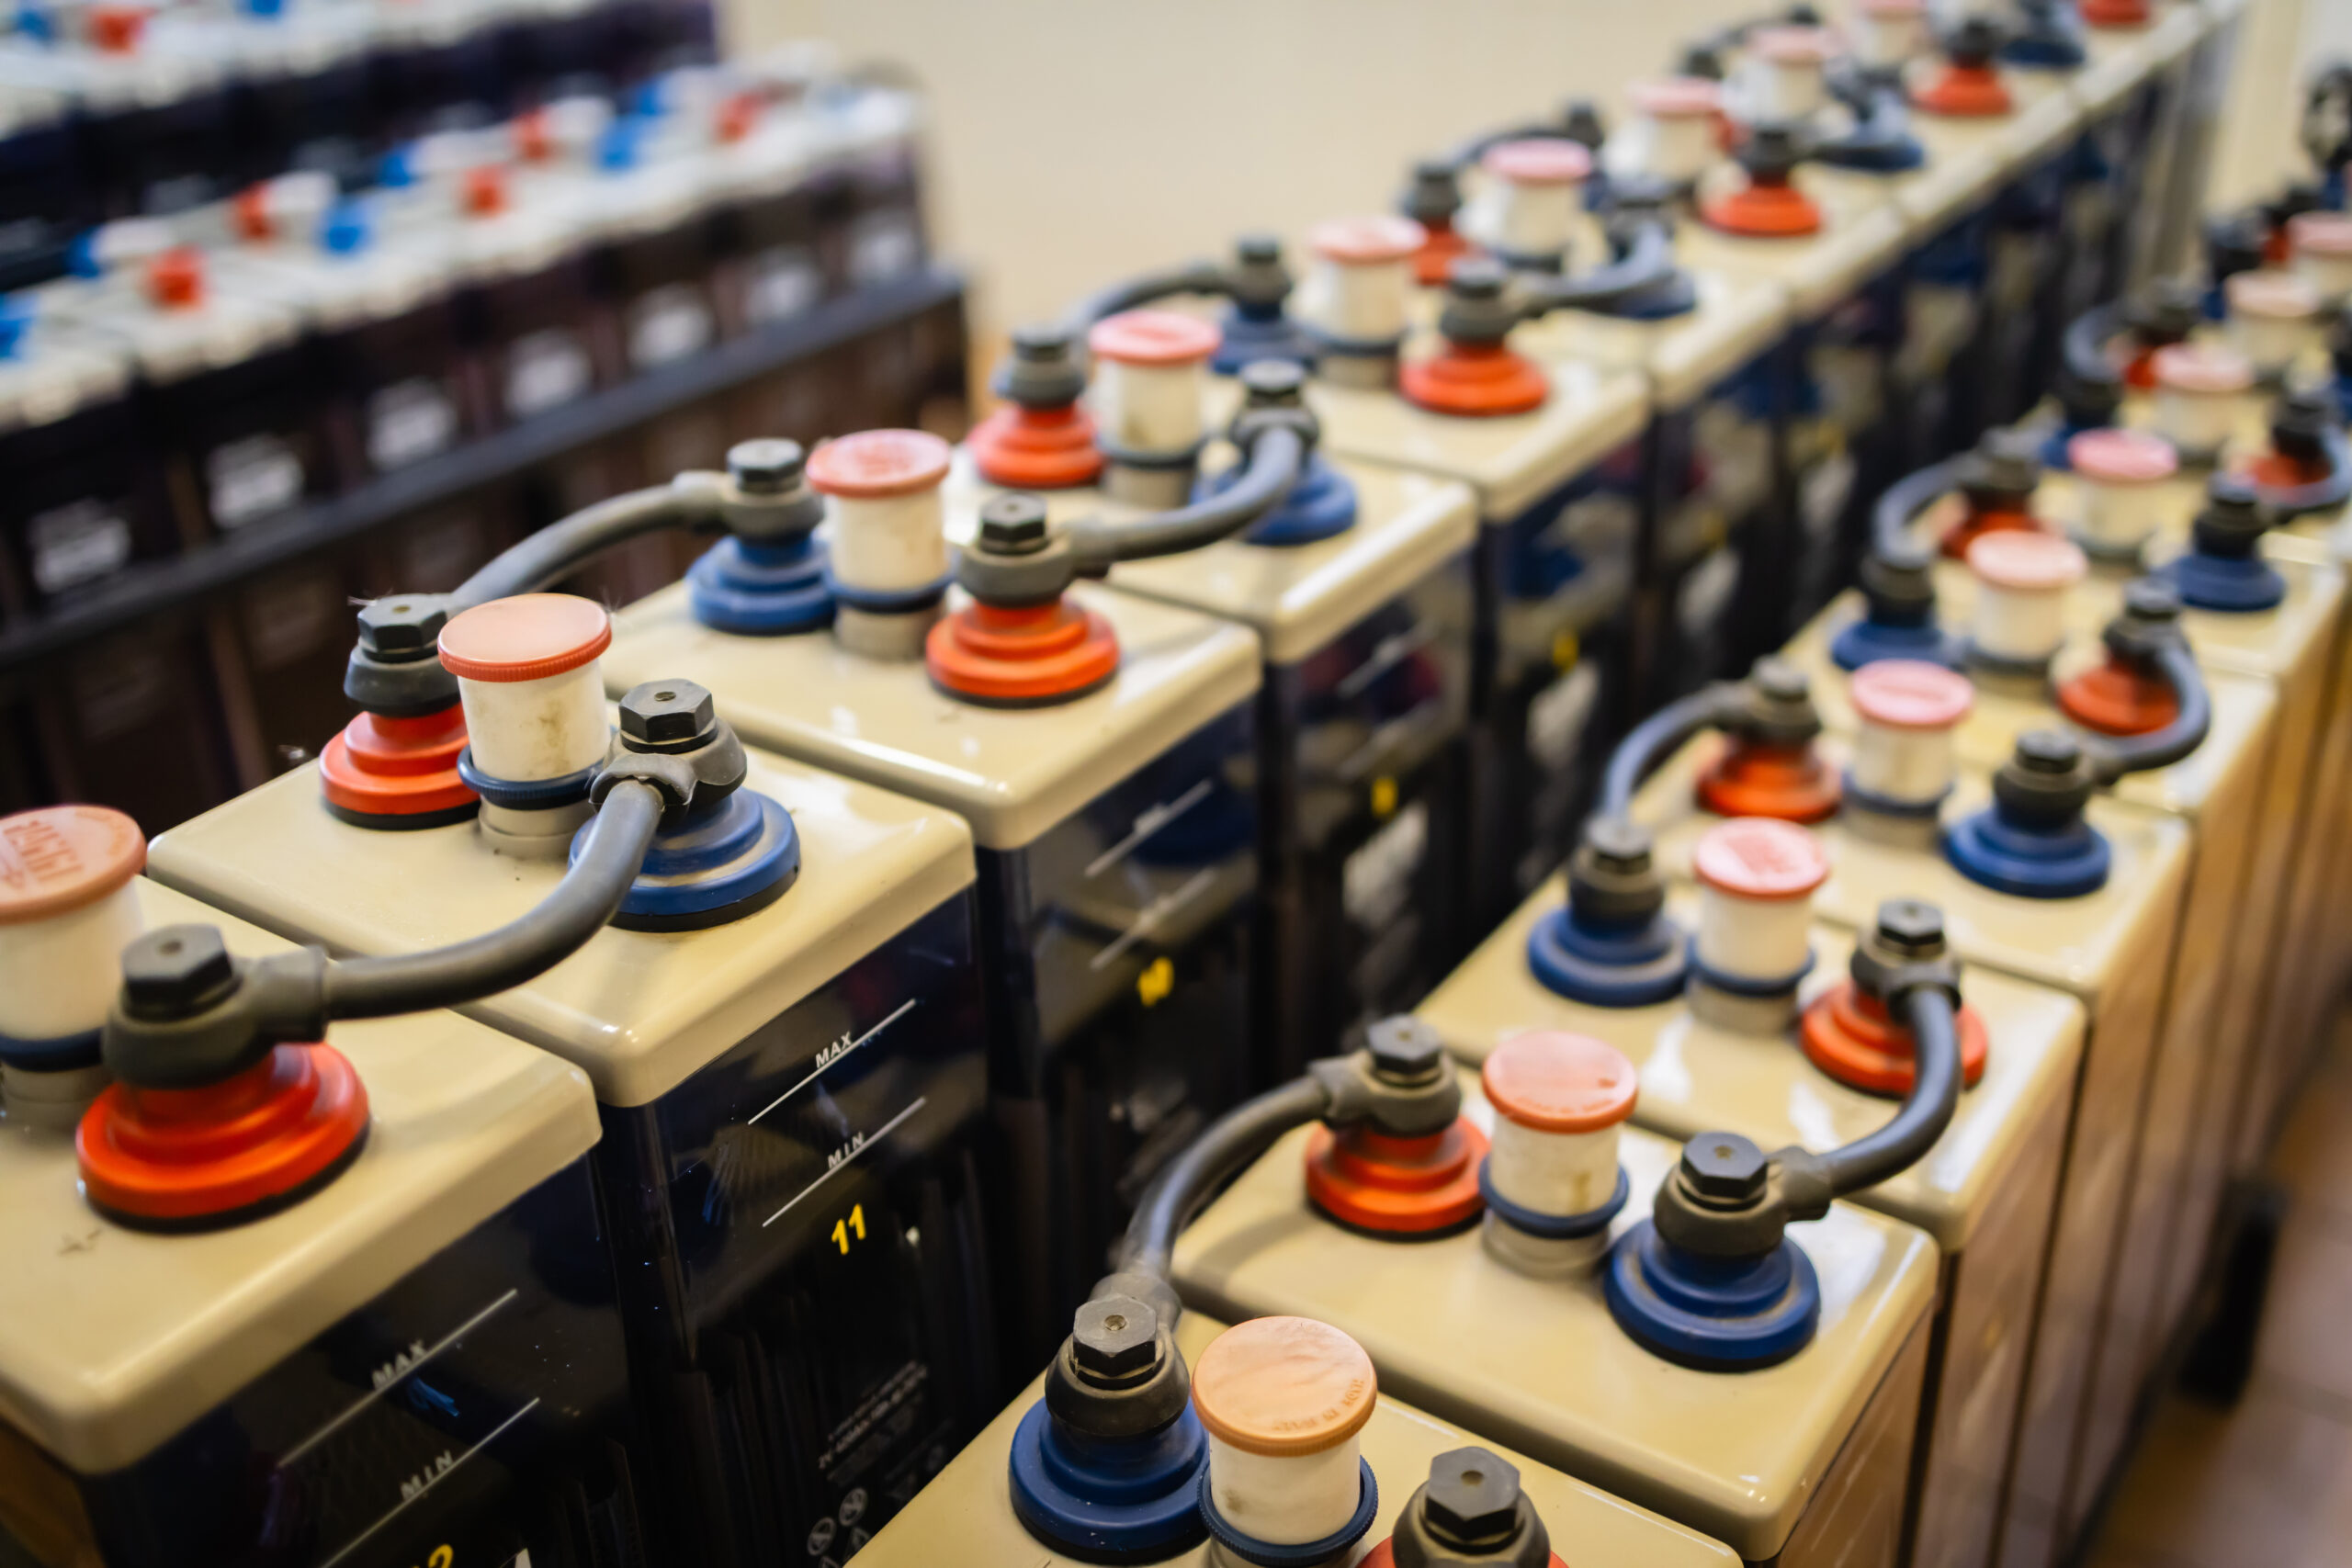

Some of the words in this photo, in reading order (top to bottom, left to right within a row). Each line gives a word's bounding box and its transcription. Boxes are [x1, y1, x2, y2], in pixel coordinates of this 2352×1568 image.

[814, 1031, 853, 1068] MAX
[828, 1132, 865, 1168] MIN
[831, 1203, 866, 1256] 11
[372, 1338, 425, 1390] MAX
[401, 1449, 454, 1500] MIN
